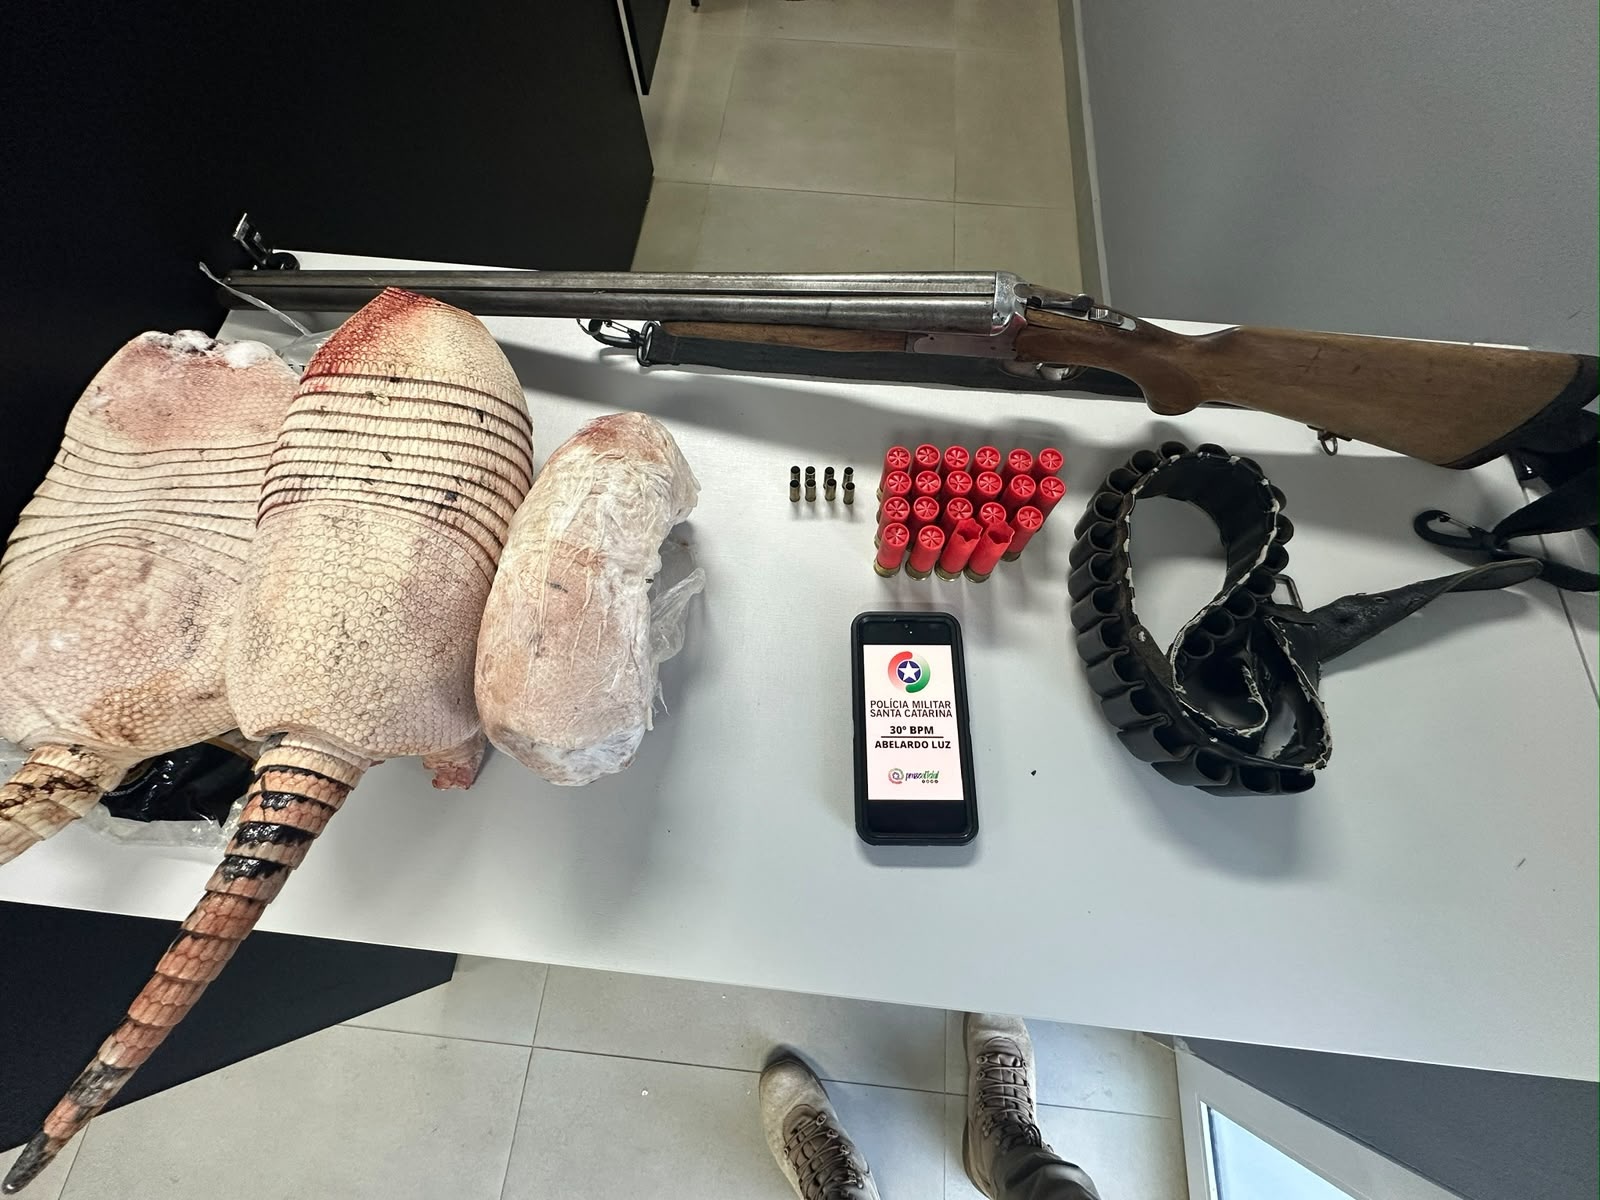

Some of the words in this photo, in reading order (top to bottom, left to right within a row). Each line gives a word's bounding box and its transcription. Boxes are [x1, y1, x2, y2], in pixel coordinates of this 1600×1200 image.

[870, 698, 909, 709] POLÍCIA
[912, 700, 951, 709] MILITAR
[870, 709, 902, 718] SANTA
[904, 709, 953, 718] CATARINA
[909, 726, 934, 735] BPM
[874, 740, 929, 749] ABELARDO
[931, 740, 952, 749] LUZ
